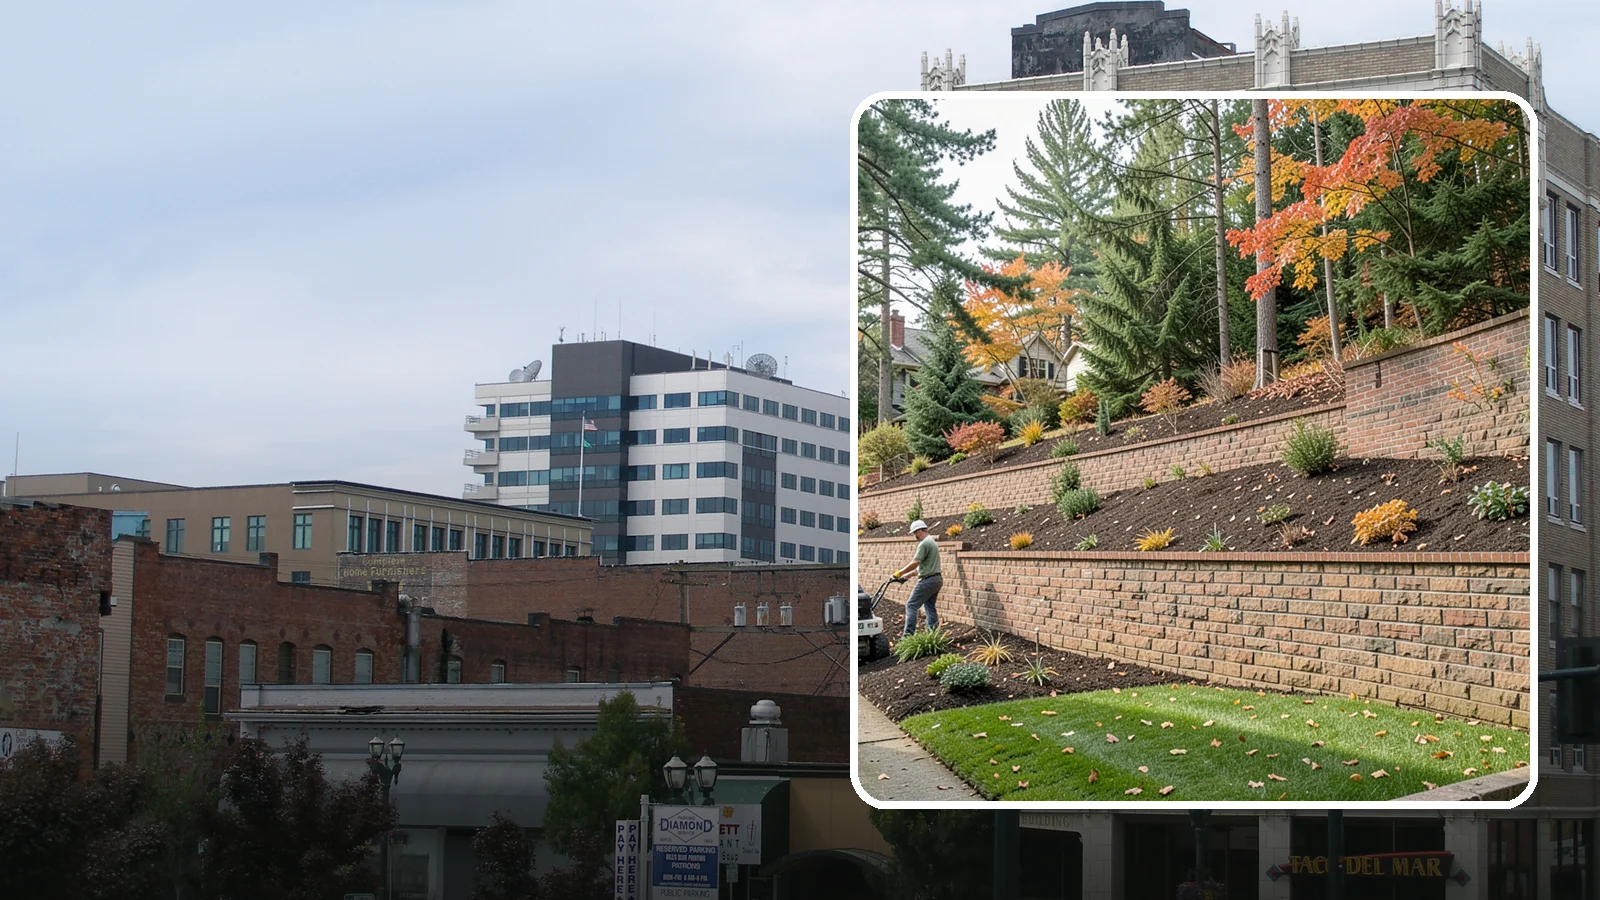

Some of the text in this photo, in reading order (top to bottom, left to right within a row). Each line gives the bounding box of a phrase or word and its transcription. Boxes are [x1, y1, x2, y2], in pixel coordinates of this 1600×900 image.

[370, 566, 427, 576] Furnishers
[660, 818, 713, 833] DIAMOND
[1022, 815, 1070, 828] BUILDING
[656, 845, 716, 854] RESERVED PARKING
[616, 825, 625, 893] PAY HERE
[627, 825, 637, 893] PAY HERE
[722, 852, 738, 861] Soup
[671, 862, 701, 870] PATRONS
[1345, 857, 1385, 875] DEL
[1391, 857, 1443, 877] MAR
[660, 889, 710, 898] PUBLIC PARKING
